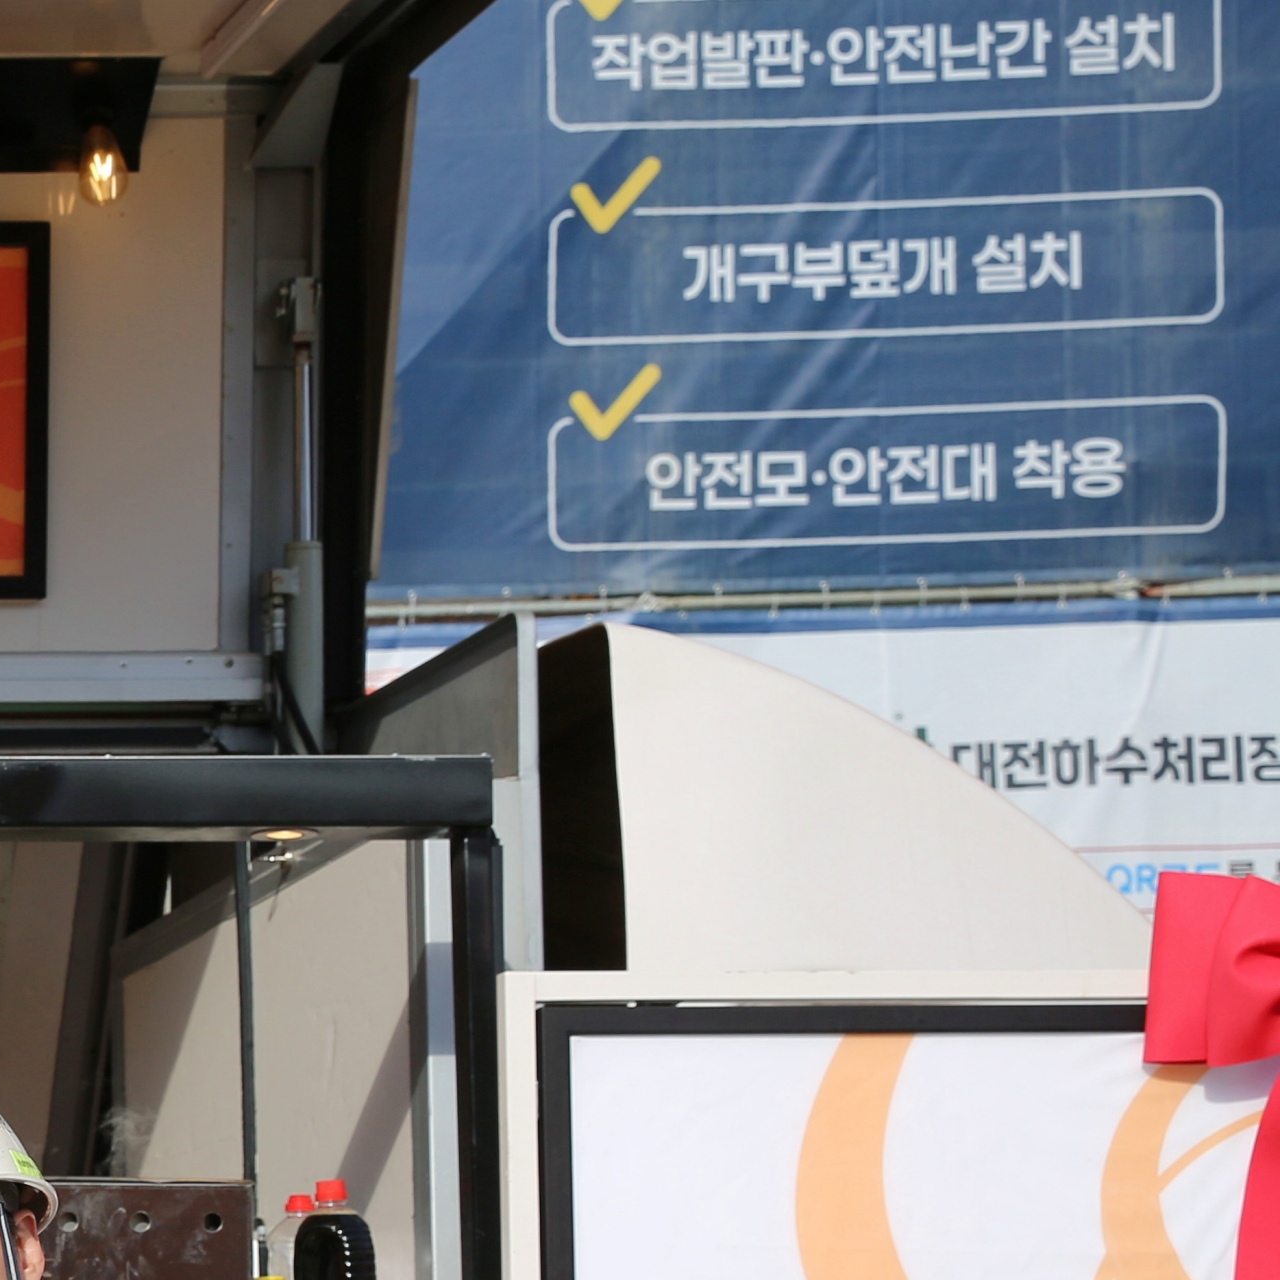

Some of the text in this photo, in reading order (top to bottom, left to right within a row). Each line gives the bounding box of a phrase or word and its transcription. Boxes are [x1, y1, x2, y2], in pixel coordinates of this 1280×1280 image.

[1065, 12, 1176, 75] 설치
[682, 230, 1083, 303] 개구부덮개 설치
[1011, 436, 1128, 500] 착용
